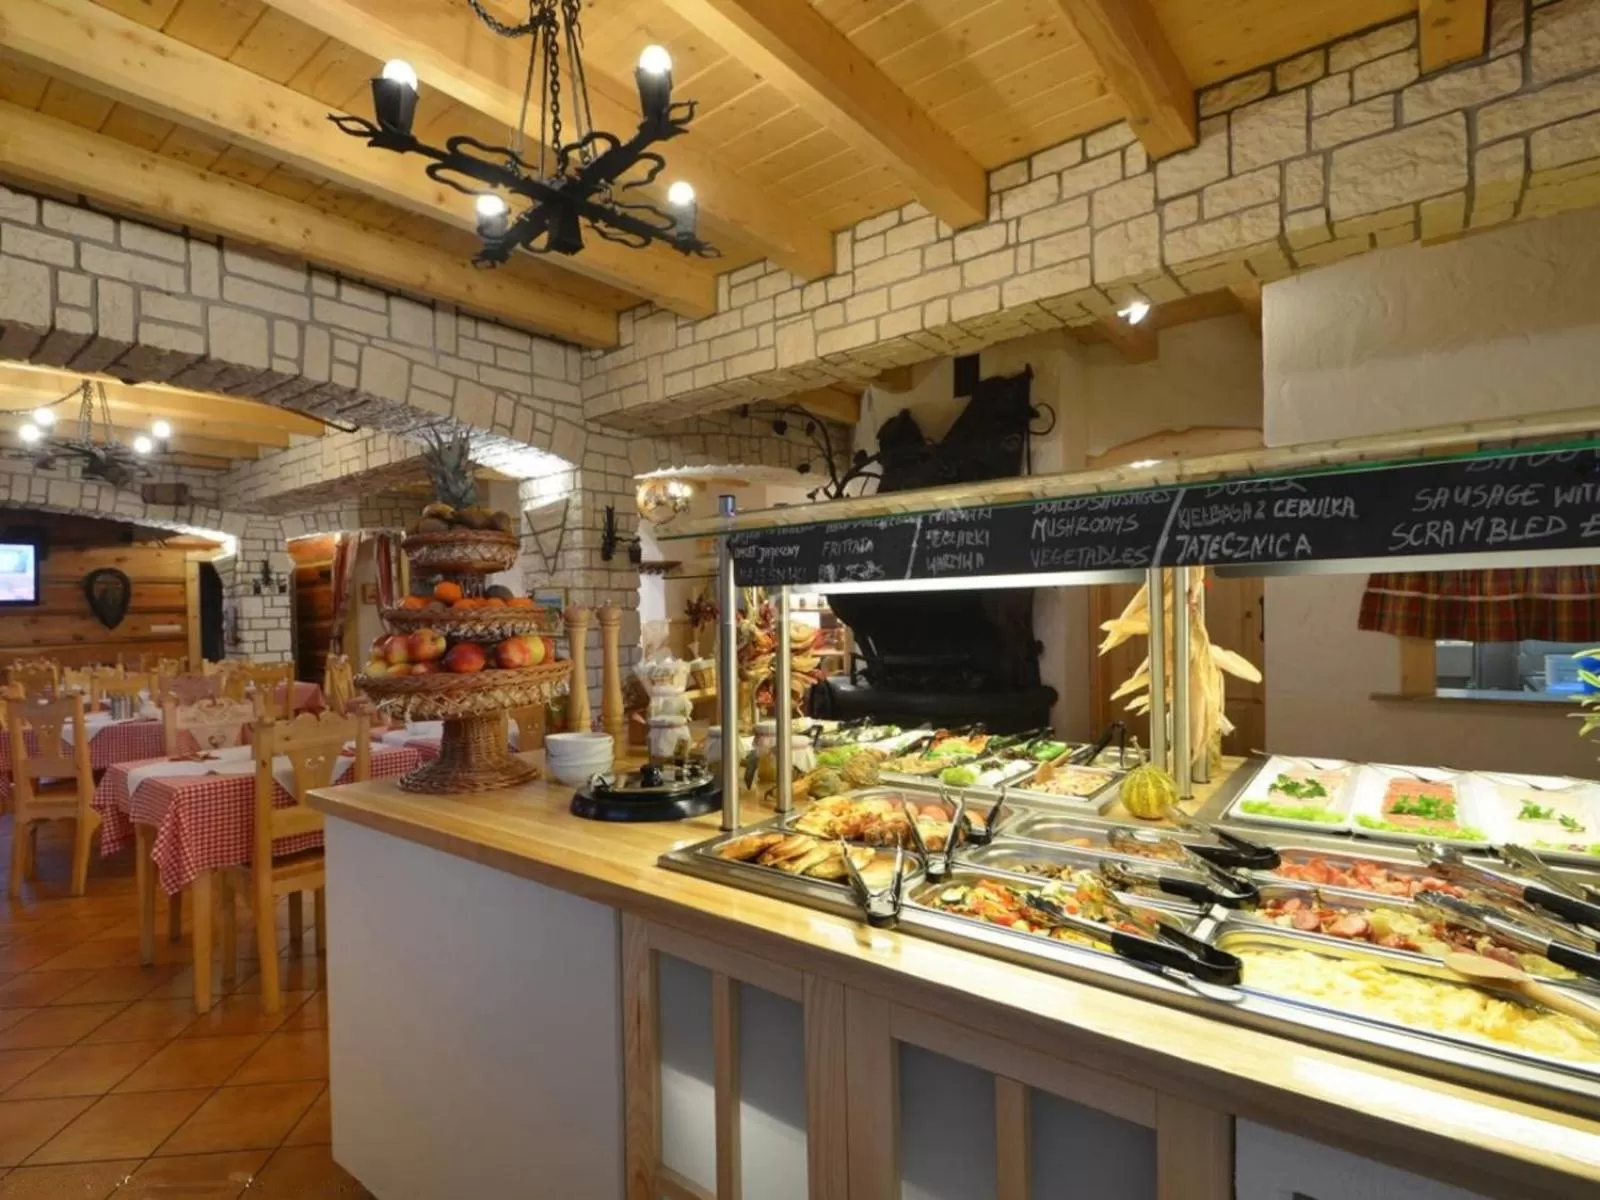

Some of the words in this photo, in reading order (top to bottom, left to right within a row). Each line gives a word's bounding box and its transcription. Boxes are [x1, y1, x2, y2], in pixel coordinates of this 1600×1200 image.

[1412, 484, 1545, 512] SAUSAGE
[1031, 514, 1140, 543] MUSHROOMS
[1388, 515, 1568, 551] SCRAMBLED
[1175, 532, 1312, 565] JAJECZNICA
